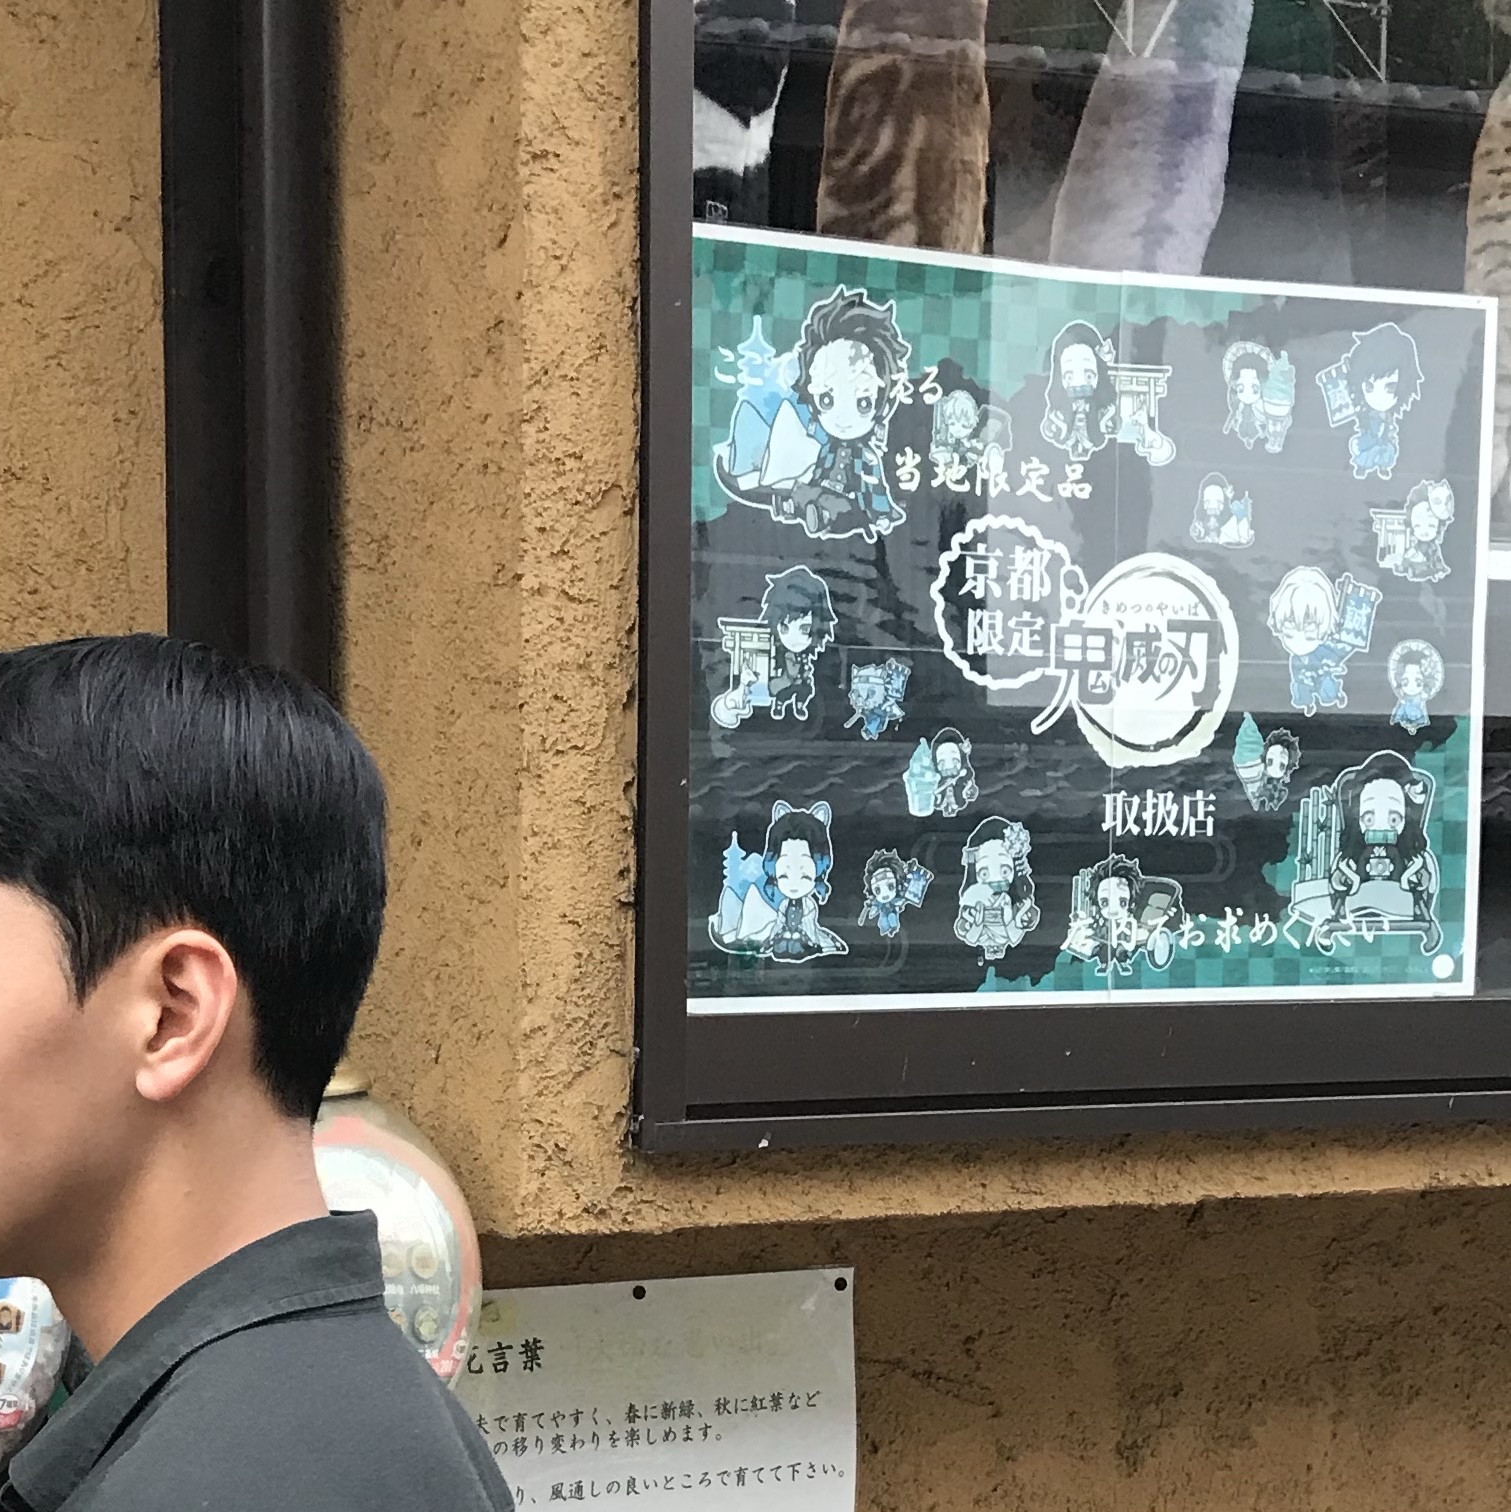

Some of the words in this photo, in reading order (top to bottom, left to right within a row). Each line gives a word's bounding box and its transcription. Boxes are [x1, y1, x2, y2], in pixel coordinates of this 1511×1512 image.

[958, 543, 1051, 602] 京都
[1101, 600, 1201, 616] きめつのやいば
[966, 608, 1045, 657] 限定
[1031, 618, 1222, 736] 鬼滅の刃
[1101, 789, 1217, 837] 取扱店
[493, 1422, 722, 1456] の移り変わりを楽しめます。
